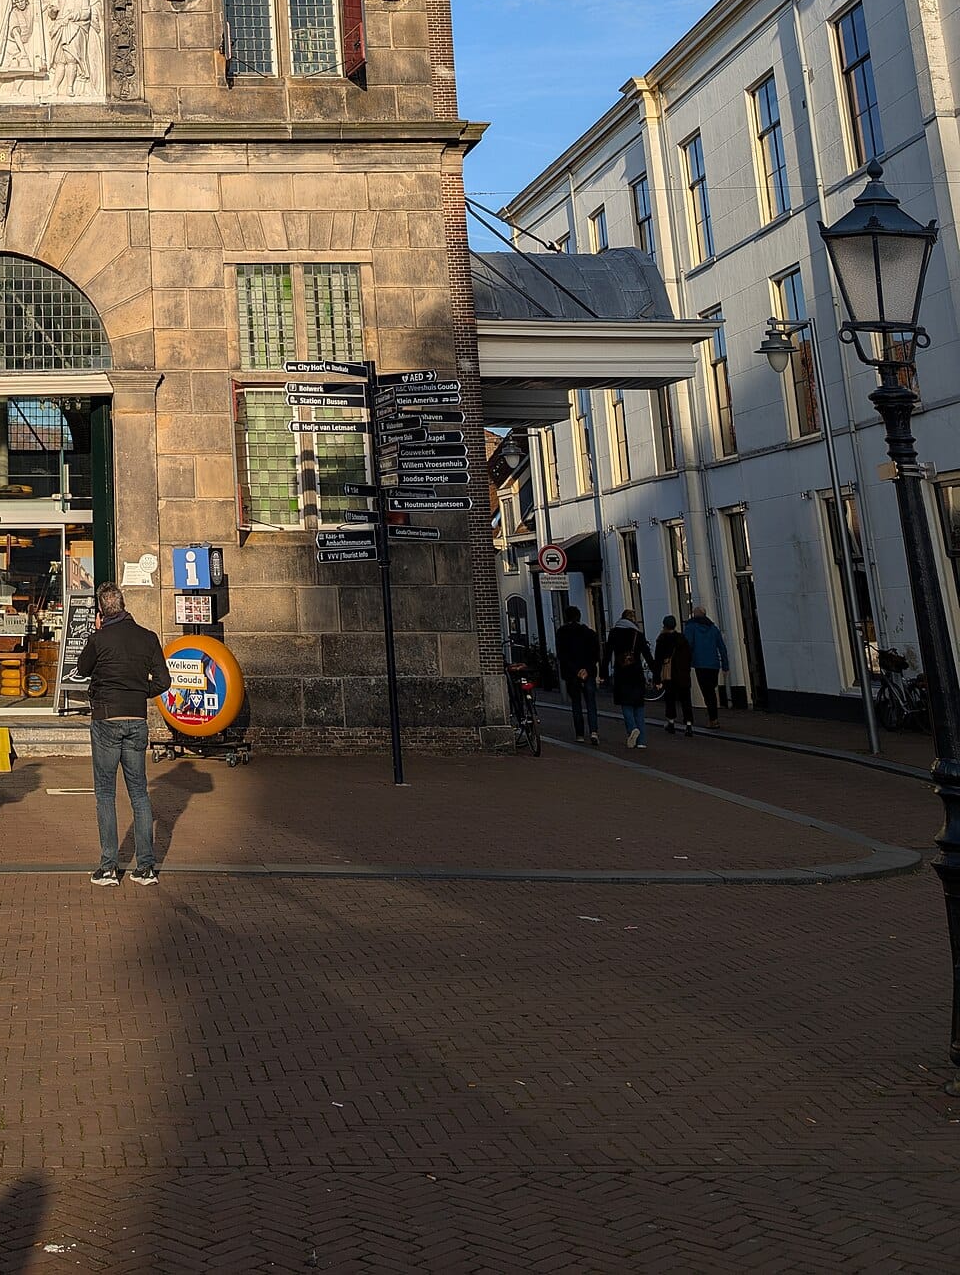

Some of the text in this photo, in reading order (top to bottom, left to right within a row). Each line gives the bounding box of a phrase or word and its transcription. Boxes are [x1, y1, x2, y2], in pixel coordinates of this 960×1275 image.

[297, 364, 310, 373] City
[410, 373, 424, 382] AED
[299, 397, 322, 405] Station
[326, 398, 348, 406] Bussen
[397, 397, 412, 405] Klein
[302, 424, 319, 433] Hofje
[331, 424, 357, 432] Letmaet
[427, 433, 446, 443] kapel
[400, 448, 437, 456] Gouwekerk
[401, 461, 424, 469] Willem
[424, 460, 464, 468] Vroesenhuis
[403, 475, 424, 483] Joodse
[425, 474, 449, 484] Poortje
[404, 500, 464, 509] Houtmansplantsoen
[327, 552, 339, 560] VVV
[342, 551, 359, 559] Tourist
[167, 660, 199, 670] Welkom
[176, 674, 202, 685] Gouda
